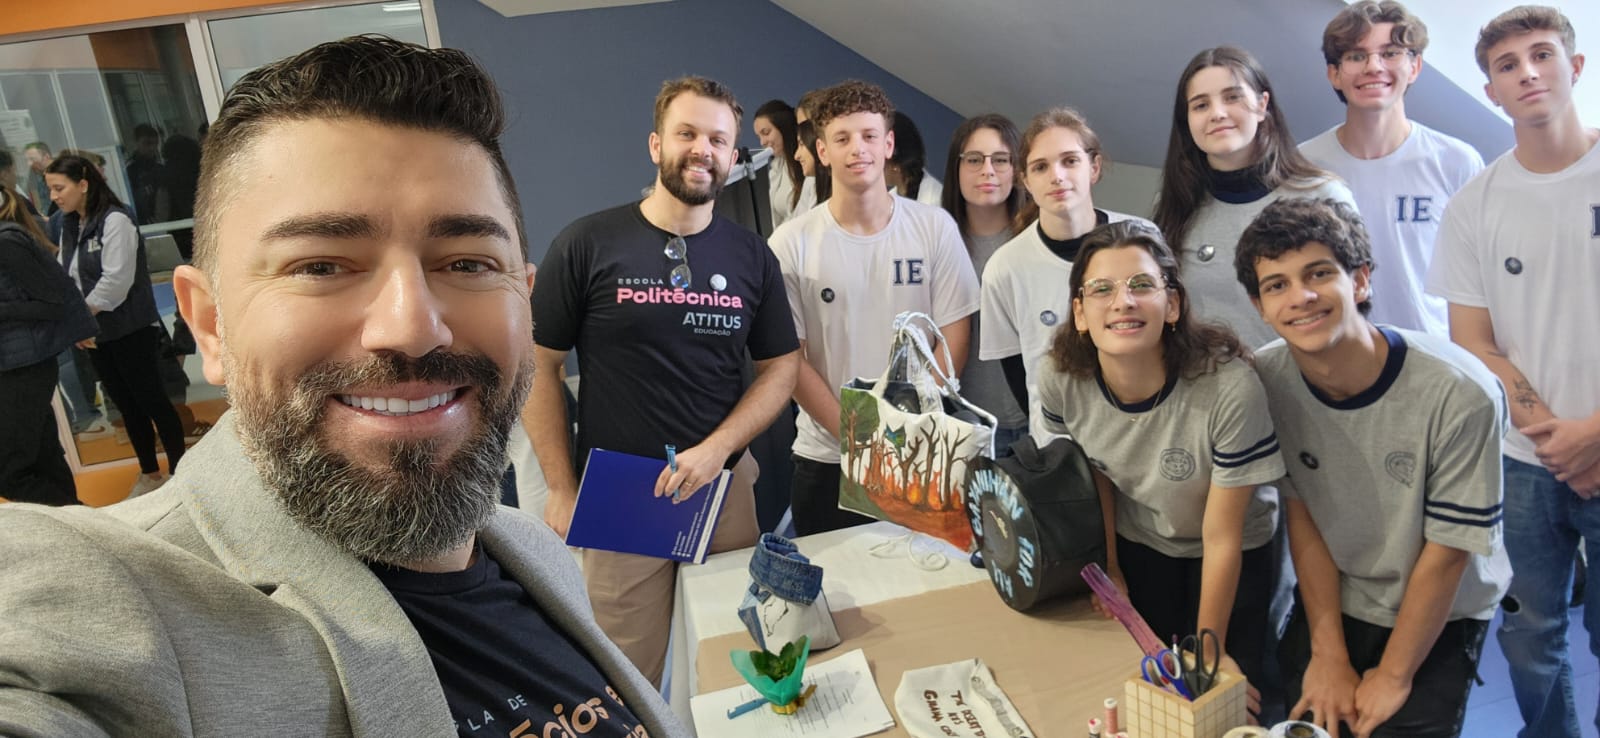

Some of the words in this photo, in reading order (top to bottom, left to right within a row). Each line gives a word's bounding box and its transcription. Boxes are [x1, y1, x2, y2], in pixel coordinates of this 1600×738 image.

[1395, 195, 1432, 222] IE
[892, 258, 924, 286] IE
[616, 286, 744, 309] Politécnica
[682, 311, 742, 329] ATITUS
[1017, 536, 1035, 587] FOR
[507, 694, 528, 711] DE
